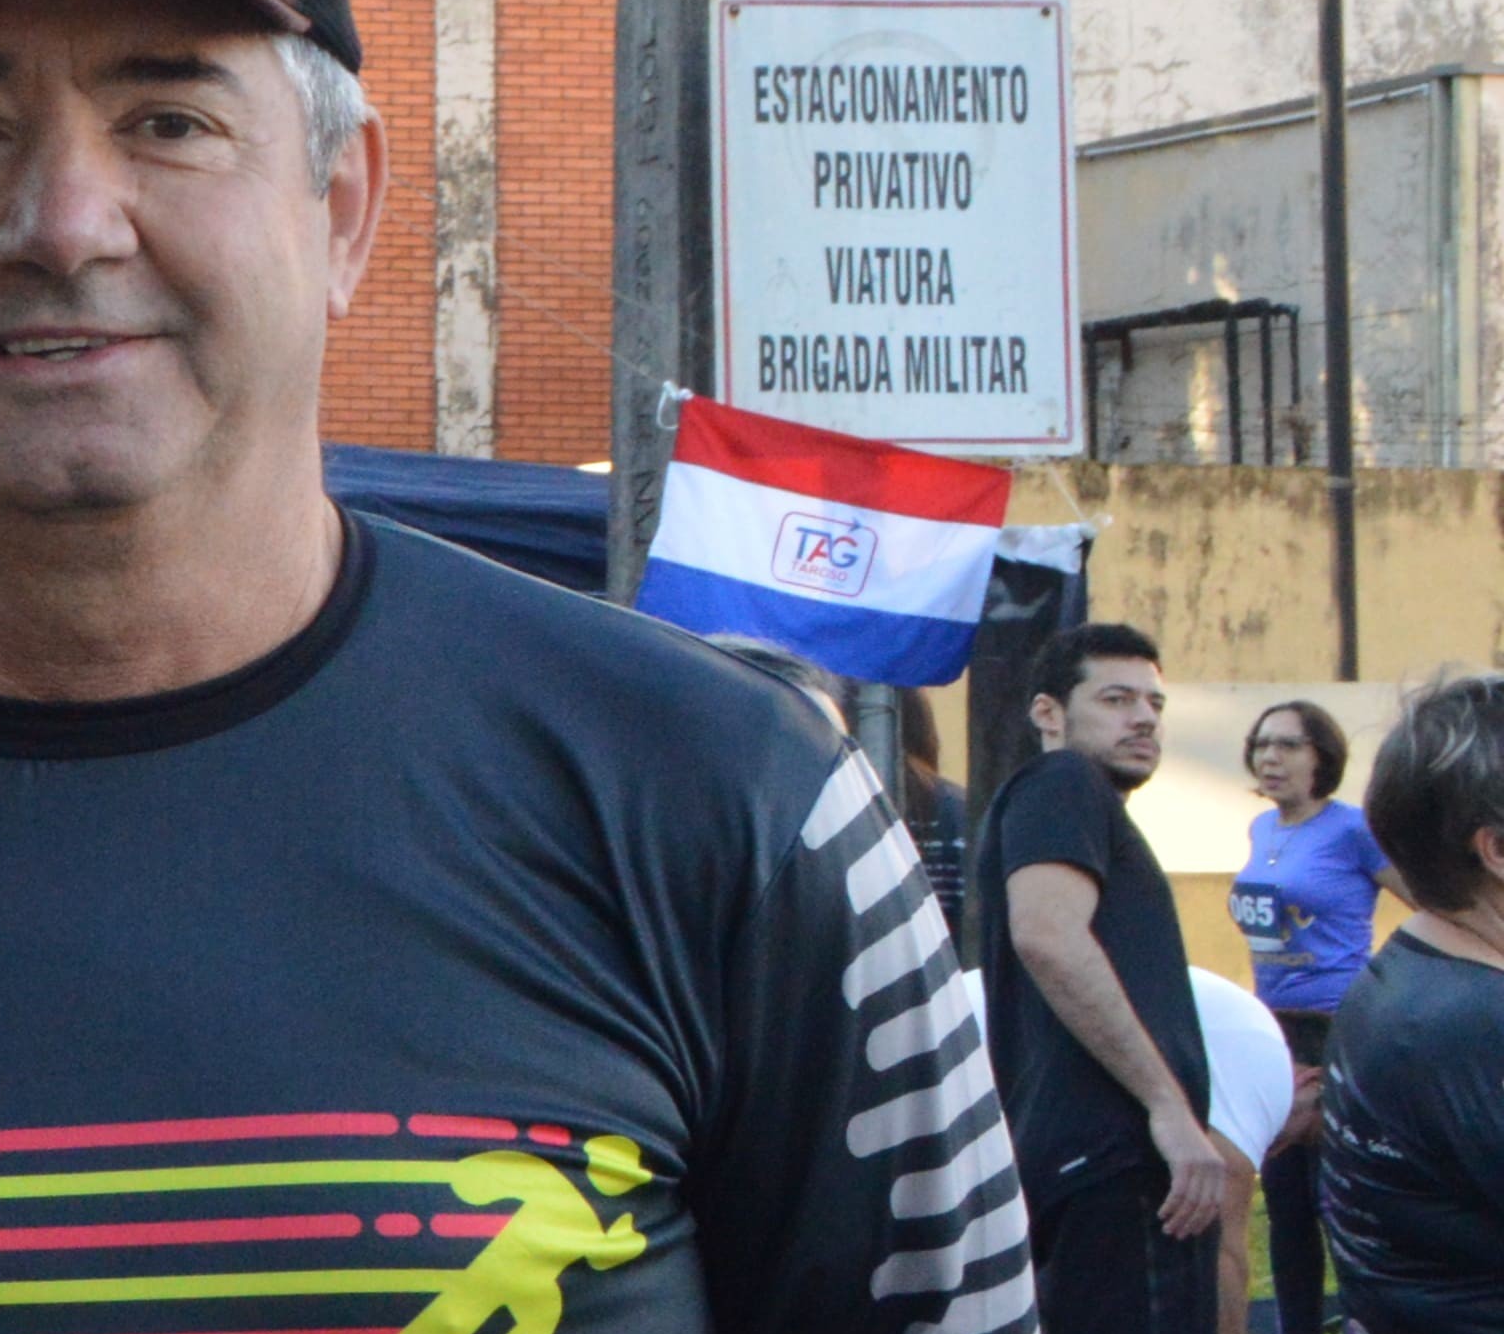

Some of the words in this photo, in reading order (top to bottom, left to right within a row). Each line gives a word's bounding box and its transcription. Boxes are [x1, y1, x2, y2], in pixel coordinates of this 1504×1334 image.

[754, 66, 1028, 123] ESTACIONAMENTO
[815, 153, 972, 210] PRIVATIVO
[826, 248, 955, 305] VIATURA
[759, 335, 893, 393] BRIGADA
[905, 336, 1028, 393] MILITAR
[796, 527, 858, 569] TAG
